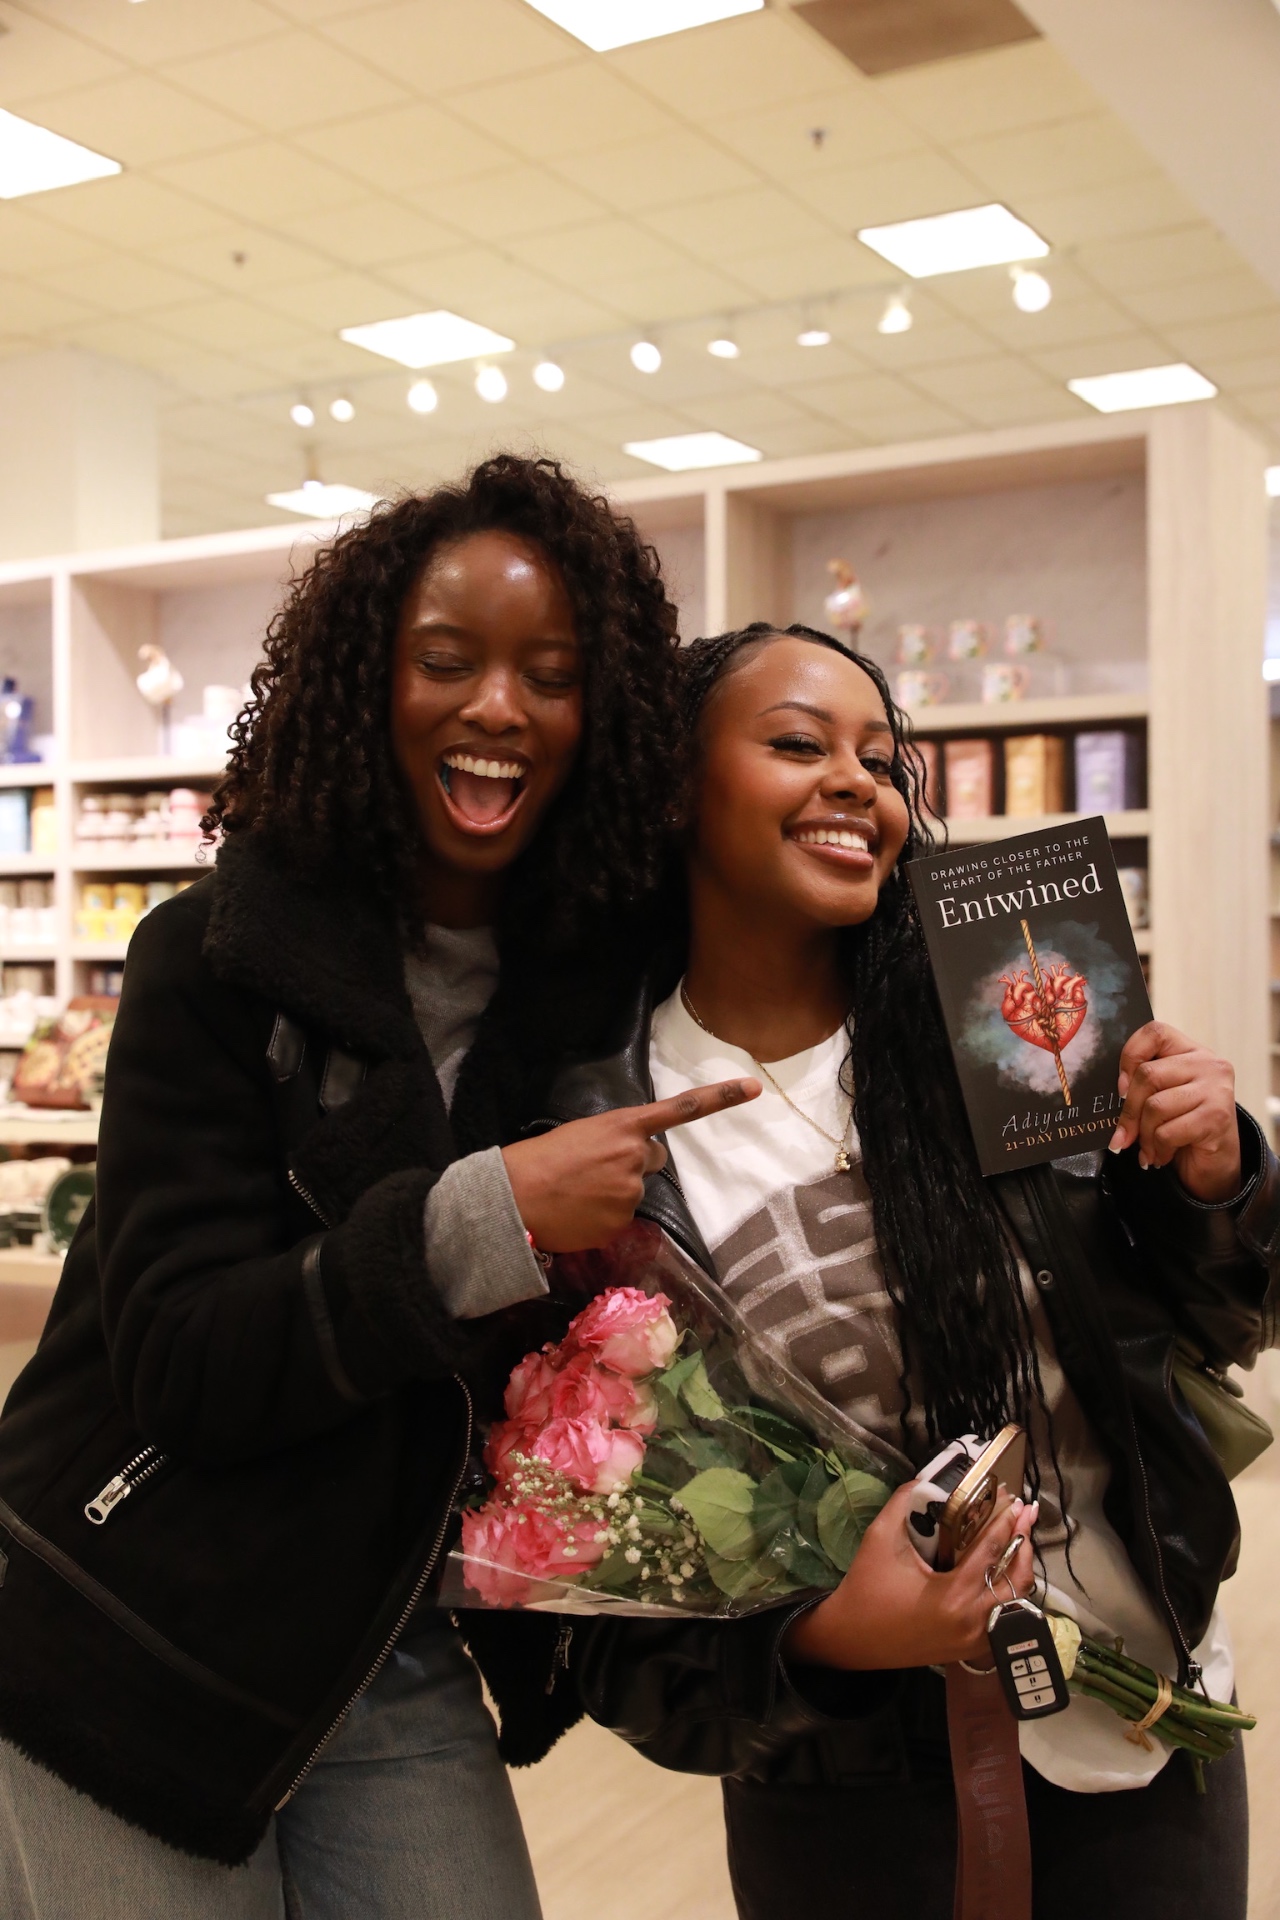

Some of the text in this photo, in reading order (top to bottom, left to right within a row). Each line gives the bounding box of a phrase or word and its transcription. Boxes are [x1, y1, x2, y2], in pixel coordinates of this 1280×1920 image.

[930, 836, 1090, 881] DRAWING CLOSER TO THE
[943, 851, 1083, 891] HEART OF THE FATHER
[935, 863, 1103, 928] Entwined
[1002, 1106, 1080, 1137] Adiyam
[1005, 1131, 1053, 1151] 21-DAY
